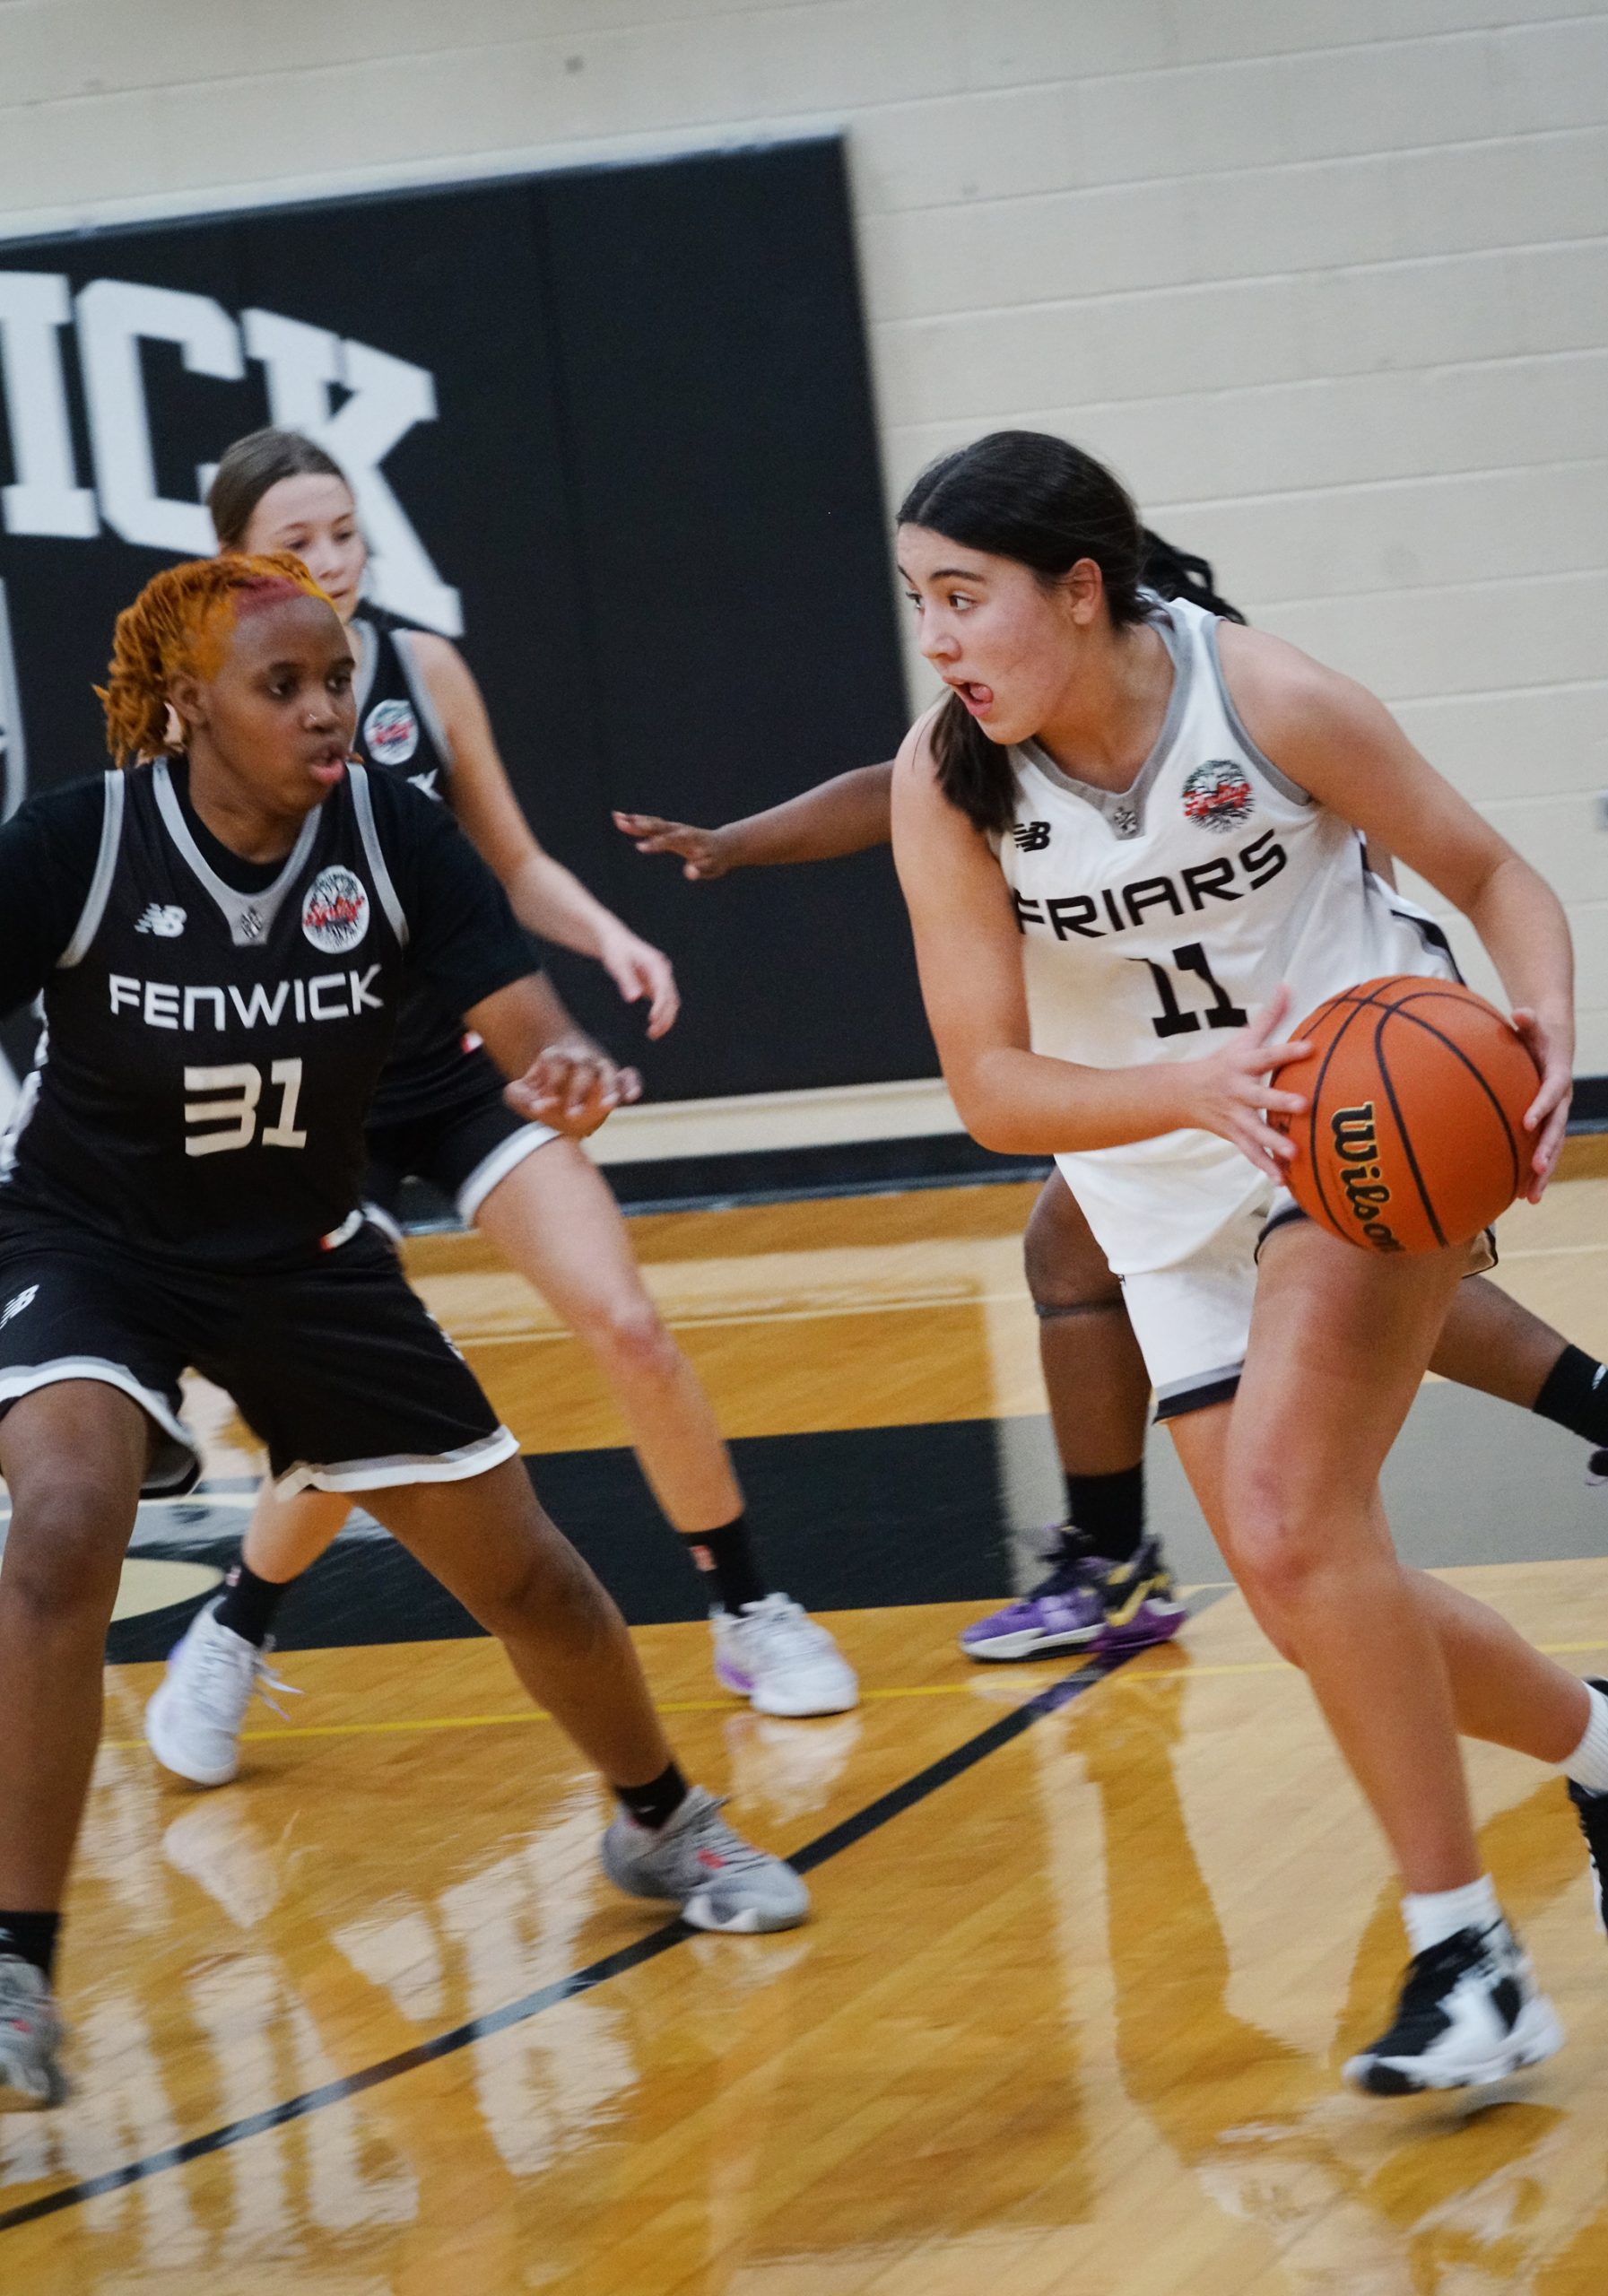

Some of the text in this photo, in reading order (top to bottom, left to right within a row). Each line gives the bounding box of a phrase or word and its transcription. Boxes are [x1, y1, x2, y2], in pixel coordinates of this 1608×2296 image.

[1012, 828, 1288, 942] FRIARS
[109, 962, 385, 1032] FENWICK
[1125, 942, 1248, 1039] 11
[184, 1057, 308, 1157] 31
